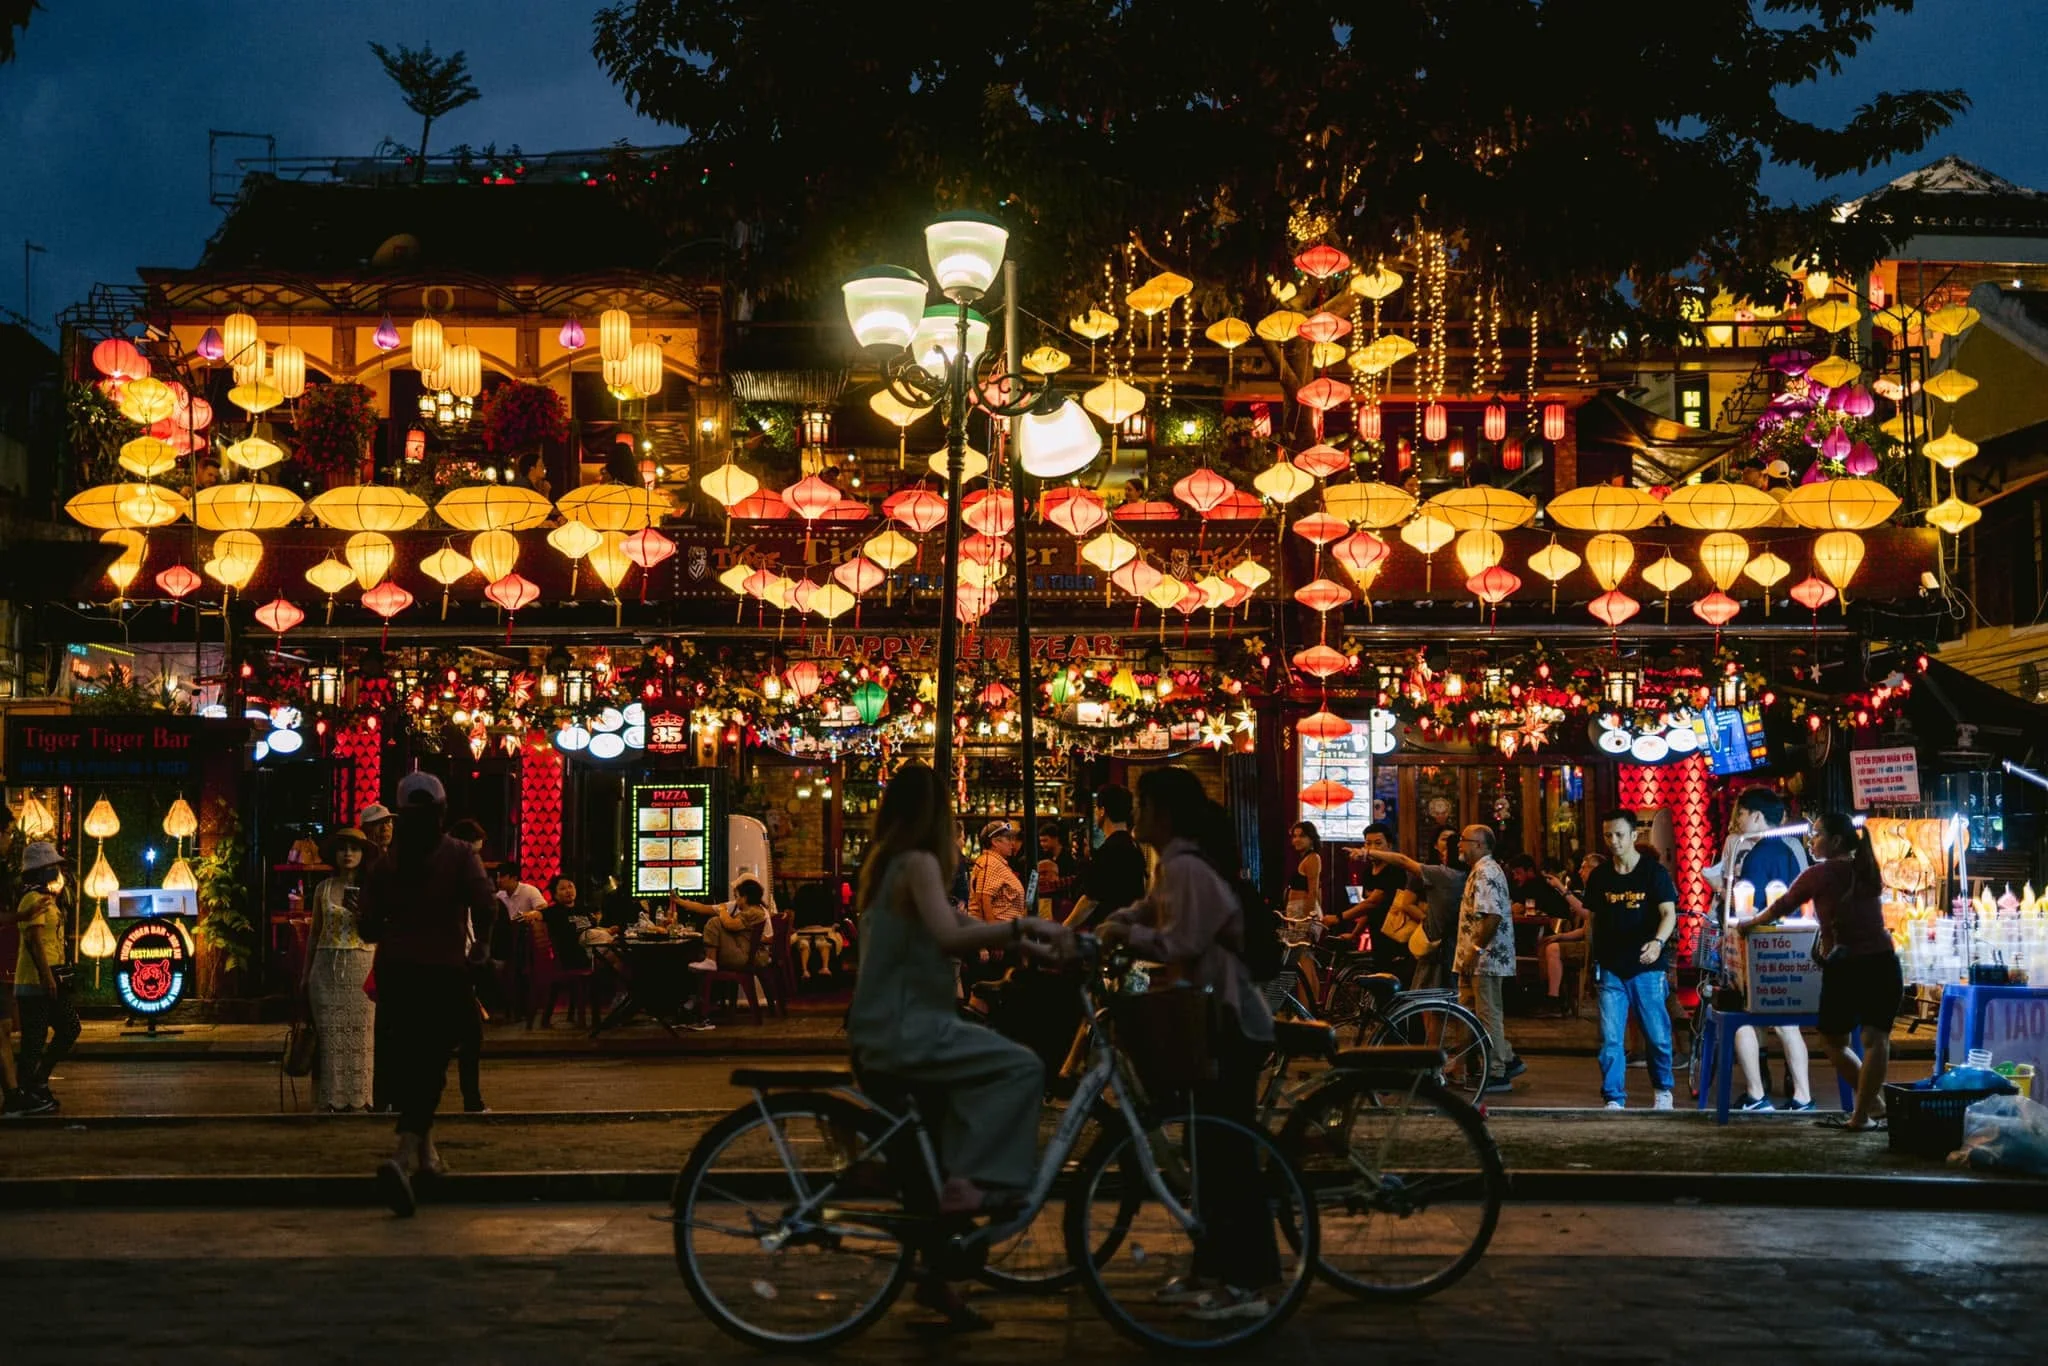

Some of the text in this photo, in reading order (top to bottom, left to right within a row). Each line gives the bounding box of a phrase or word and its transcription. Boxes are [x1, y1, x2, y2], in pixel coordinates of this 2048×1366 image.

[812, 635, 927, 660] HAPPY
[955, 636, 1011, 659] EW
[23, 726, 192, 752] Tiger Tiger Bar
[652, 726, 683, 744] 35
[653, 790, 689, 801] PIZZA
